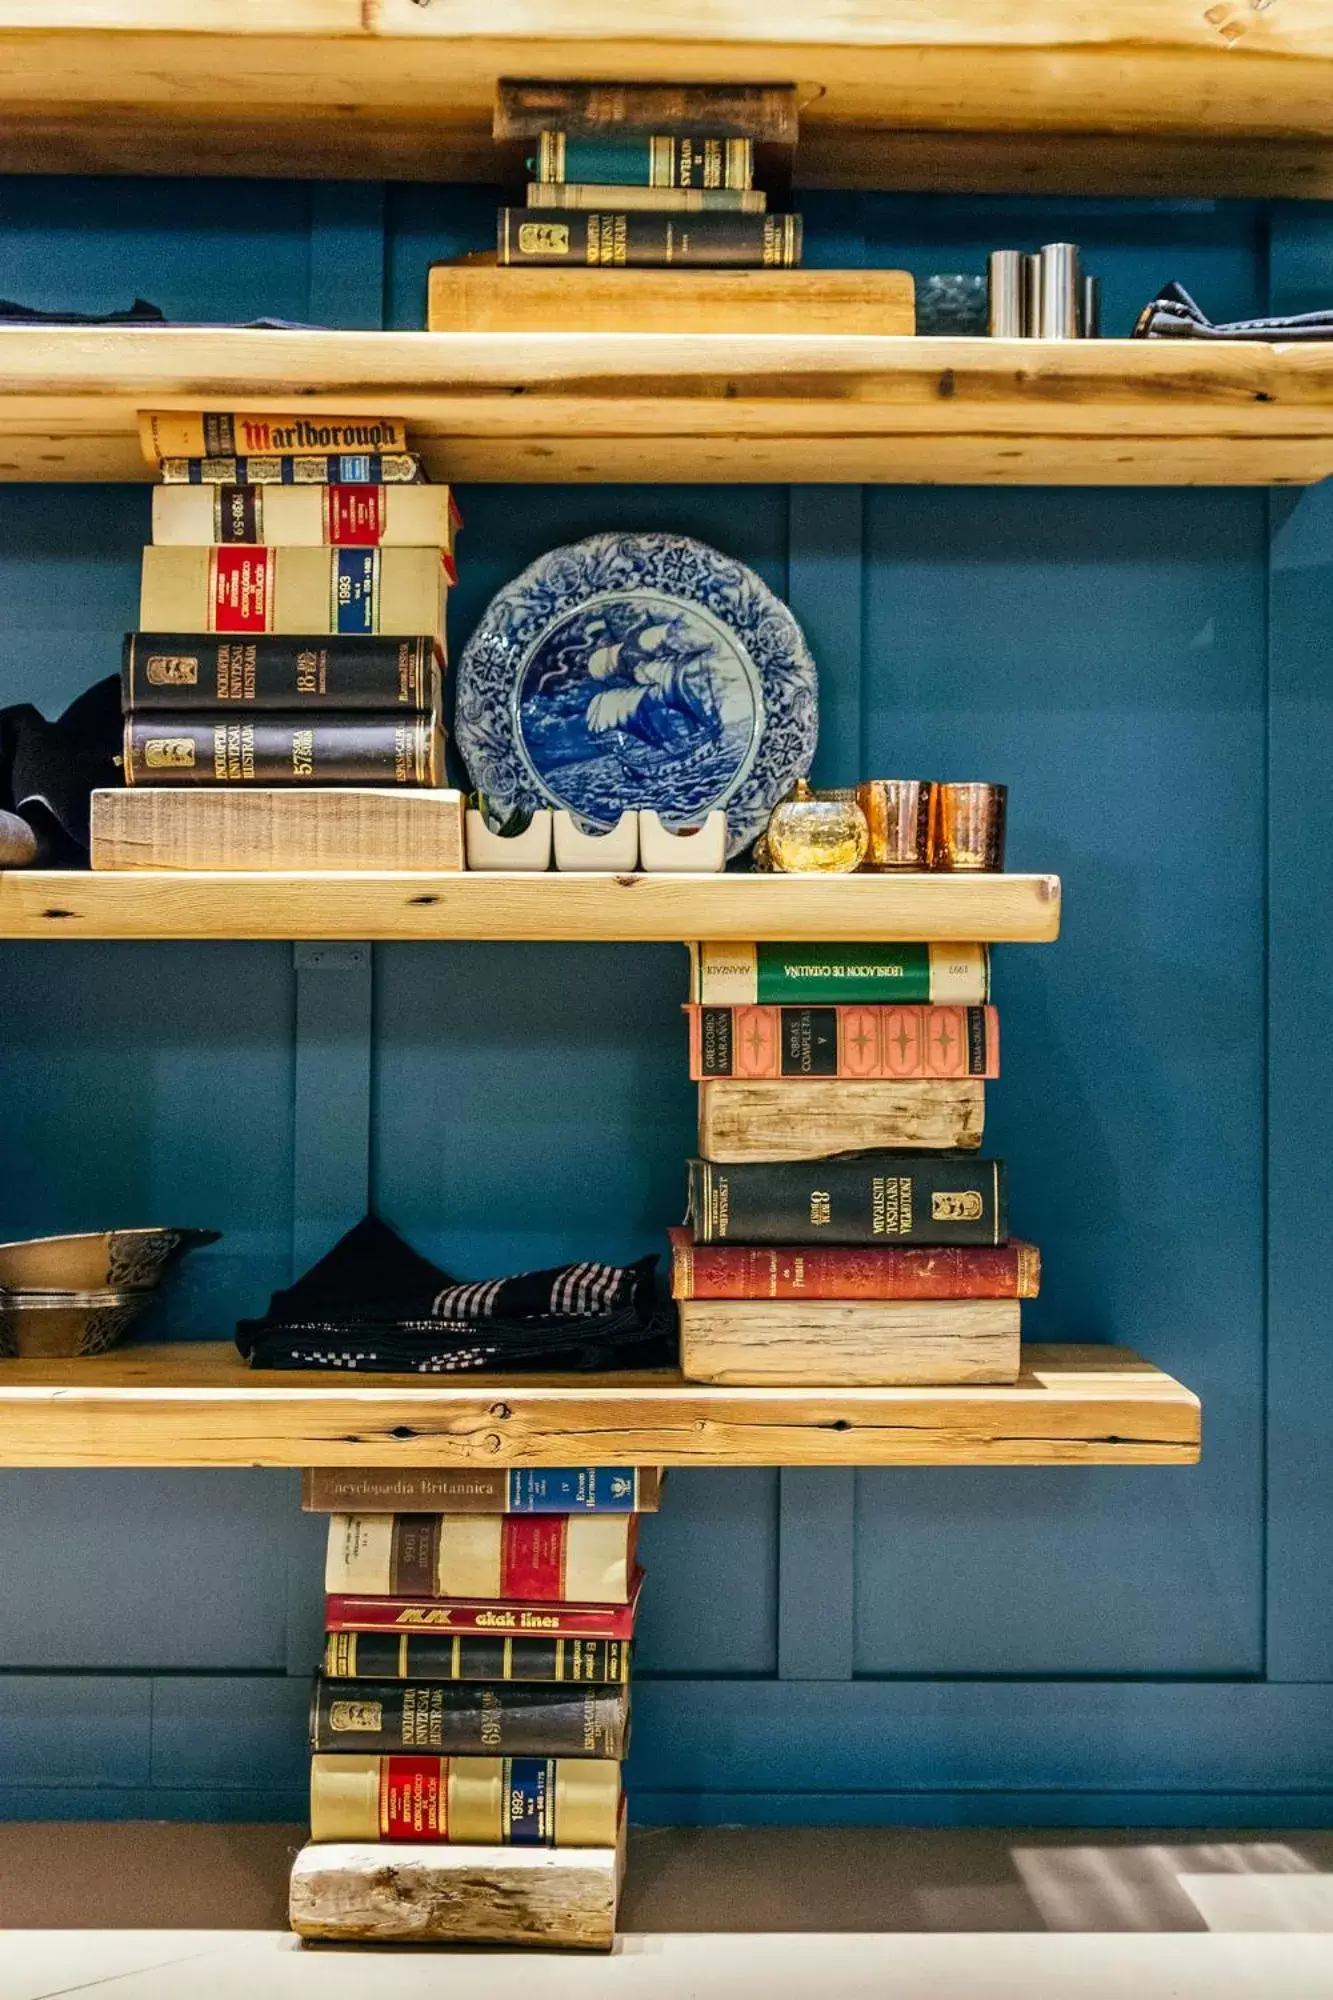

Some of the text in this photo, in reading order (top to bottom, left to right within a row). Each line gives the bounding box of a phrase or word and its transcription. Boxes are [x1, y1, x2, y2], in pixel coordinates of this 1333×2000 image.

[680, 138, 692, 187] NOVELAS
[243, 418, 397, 451] Marlborough
[240, 560, 250, 618] CRONOLÓGICO
[254, 563, 264, 615] LEGISLACIÓN
[339, 575, 351, 606] 1993
[217, 644, 229, 699] ENCICLOPEDIA
[230, 644, 243, 699] UNIVERSAL
[244, 644, 256, 699] ILUSTRADA
[214, 725, 227, 779] ENCICLOPEDIA
[228, 725, 241, 779] UNIVERSAL
[242, 724, 255, 779] ILUSTRADA
[293, 755, 312, 775] 57
[784, 965, 831, 978] CATALUÑA
[833, 966, 845, 977] DE
[705, 1013, 715, 1069] GREGORIO
[791, 1021, 801, 1058] OBRAS
[811, 1191, 830, 1203] 8
[872, 1177, 885, 1234] ILUSTRADA
[886, 1177, 899, 1234] UNIVERSAL
[900, 1177, 912, 1234] ENCICLOPEDIA
[421, 1480, 494, 1496] Britannica
[475, 1611, 516, 1627] akak
[521, 1612, 560, 1628] lines
[402, 1687, 415, 1745] ENCICLOPEDIA
[416, 1687, 429, 1745] UNIVERSAL
[430, 1689, 442, 1745] ILUSTRADA
[481, 1723, 501, 1745] 69
[413, 1773, 423, 1832] CRONOLÓGICO
[428, 1776, 438, 1829] LEGISLACIÓN
[511, 1790, 524, 1821] 1992
